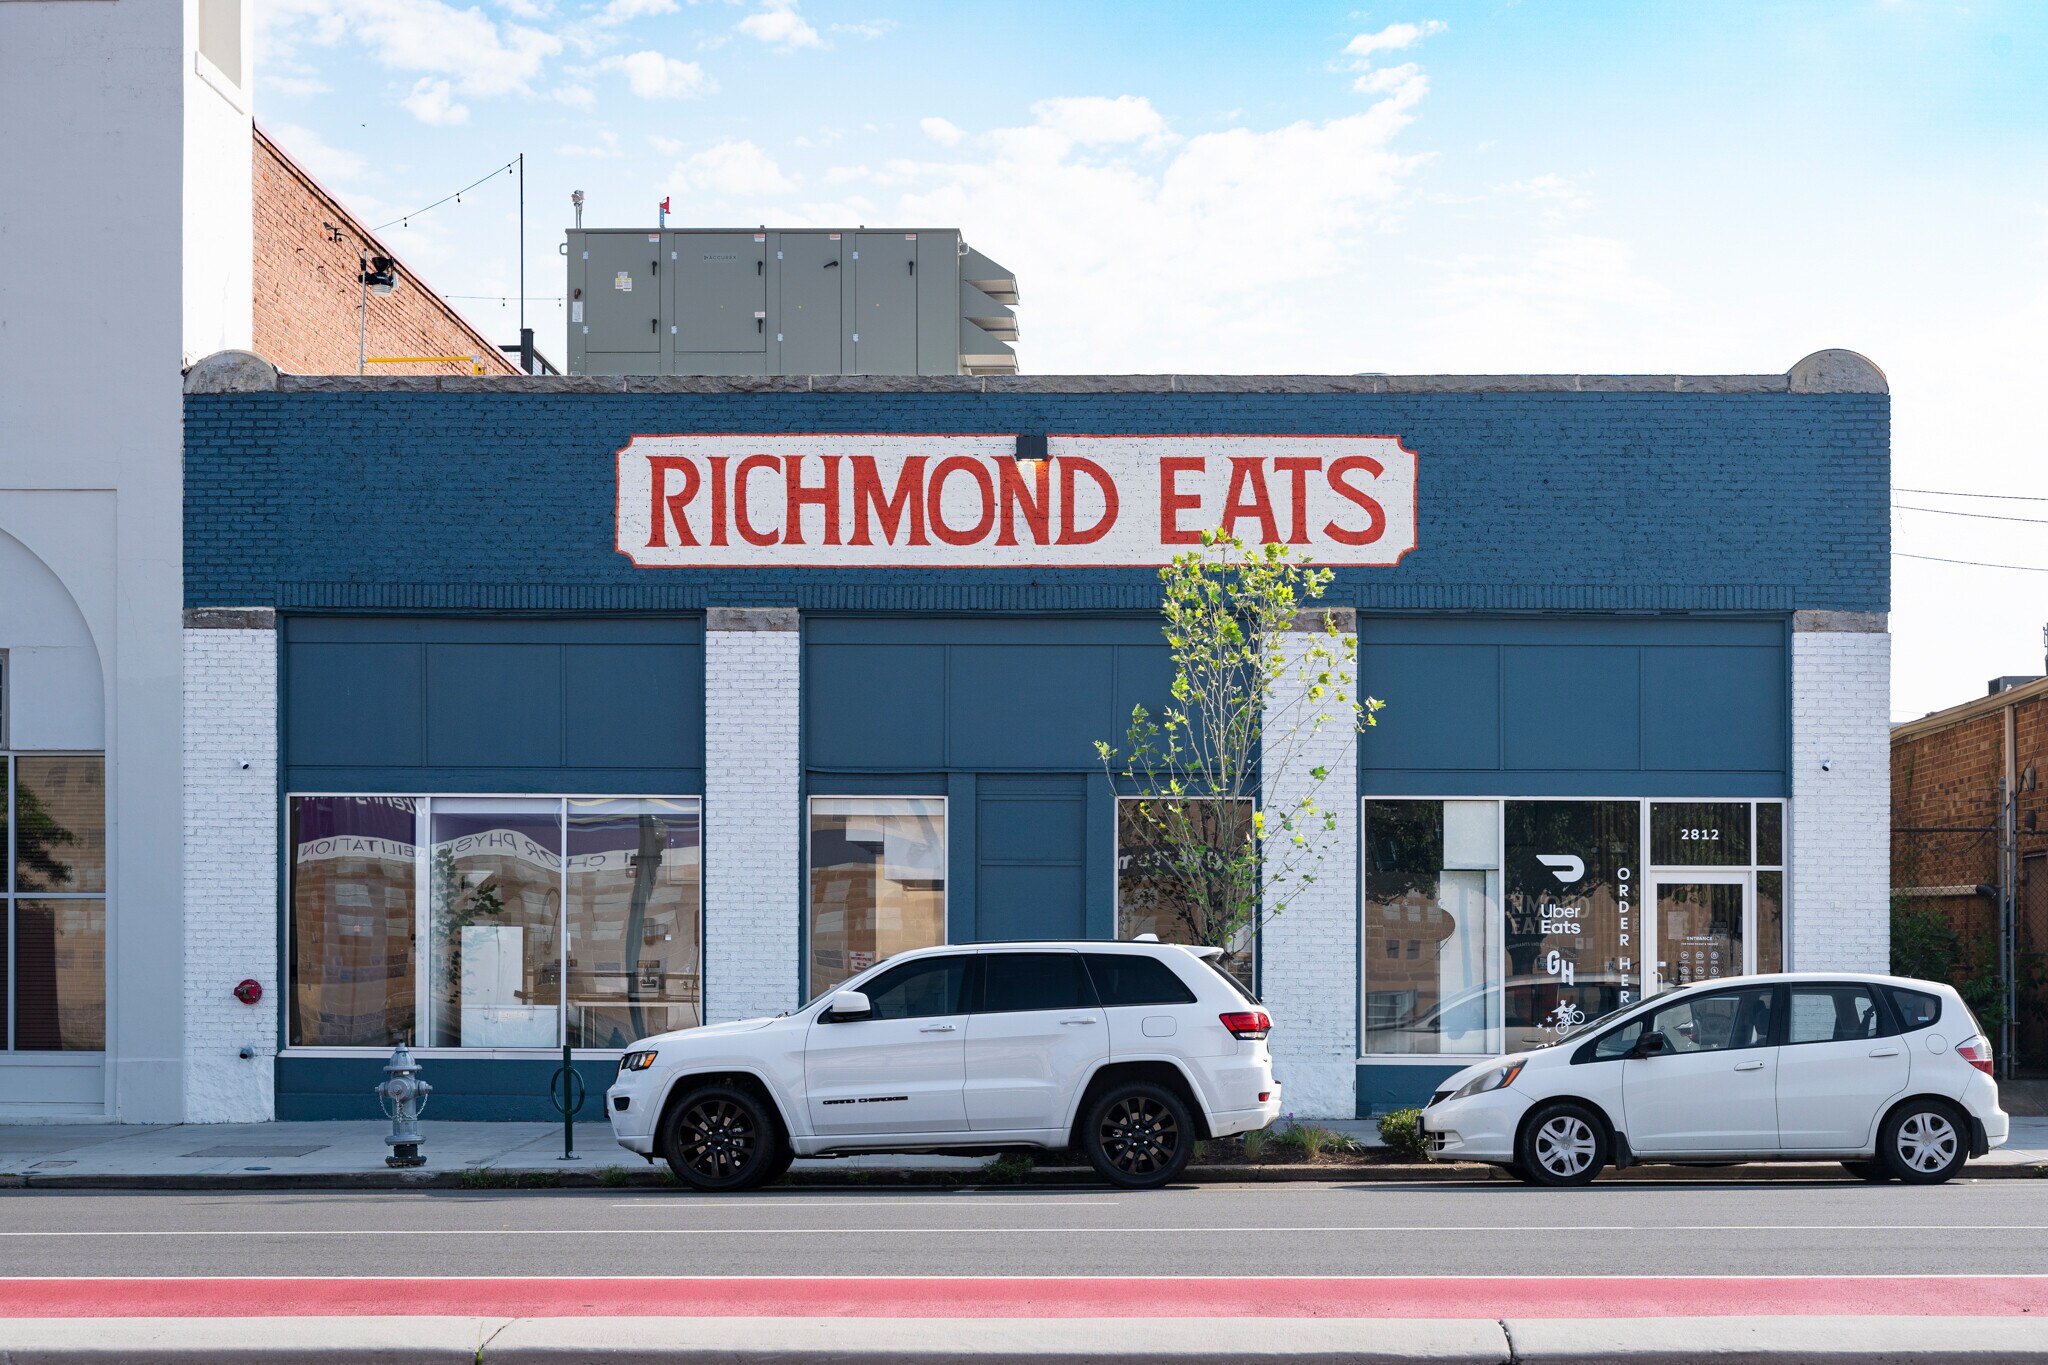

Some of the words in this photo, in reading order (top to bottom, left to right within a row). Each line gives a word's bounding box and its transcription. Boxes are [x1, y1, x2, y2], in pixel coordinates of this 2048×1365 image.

[645, 454, 1119, 548] RICHMOND
[1160, 455, 1386, 546] EATS
[1681, 828, 1719, 840] 2812
[1541, 903, 1581, 918] Uber
[1617, 867, 1631, 946] ORDER
[1541, 919, 1581, 934] Eats
[1546, 950, 1574, 986] GH
[1619, 957, 1631, 1003] HER
[858, 1095, 909, 1103] CHEROKEE
